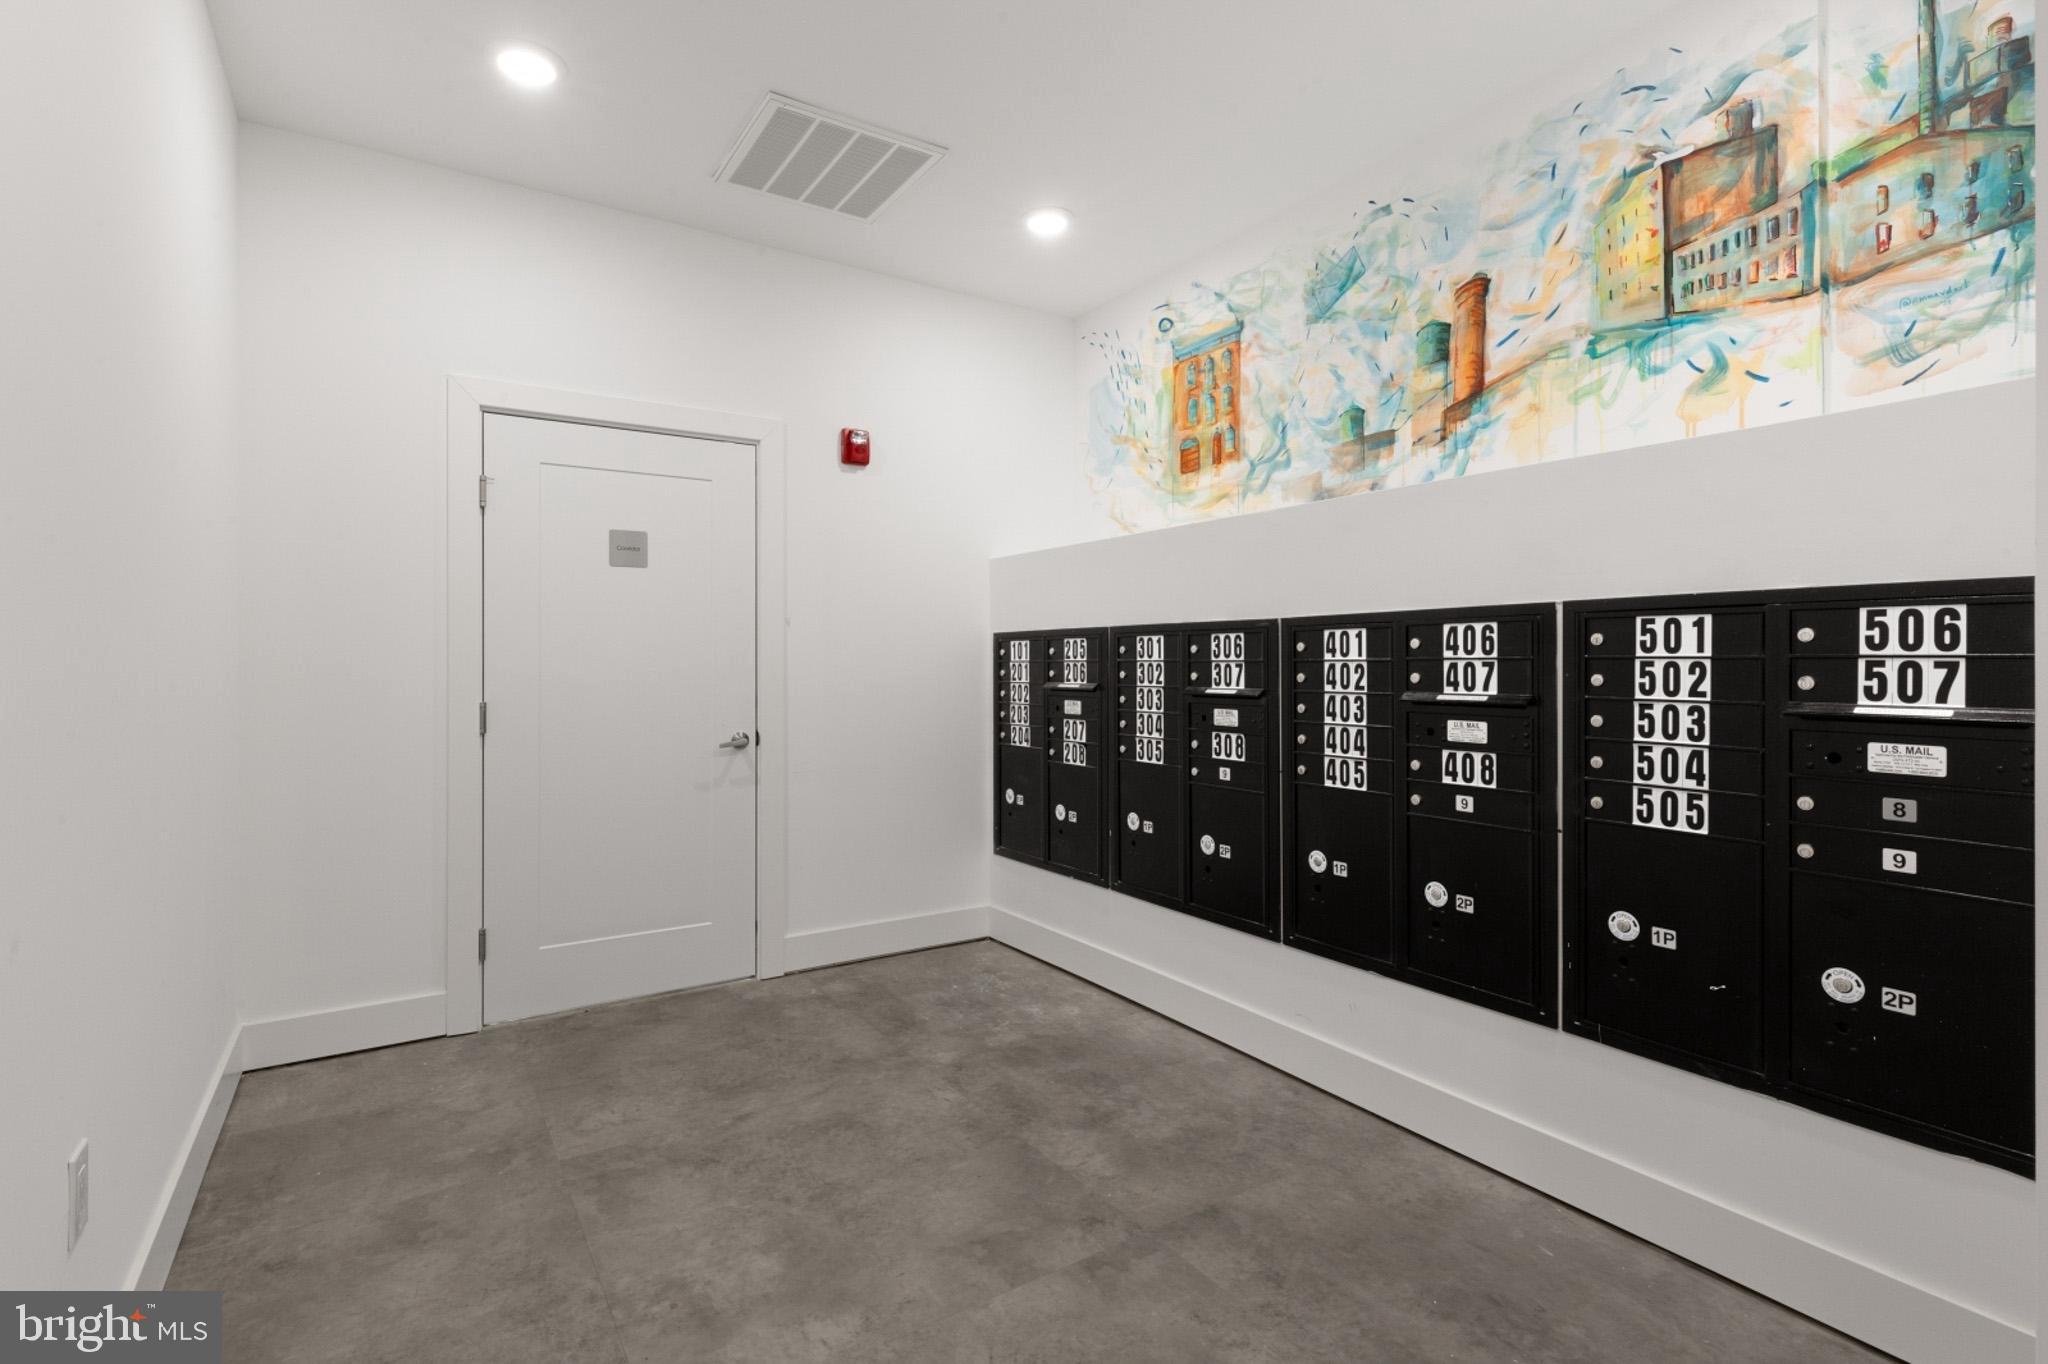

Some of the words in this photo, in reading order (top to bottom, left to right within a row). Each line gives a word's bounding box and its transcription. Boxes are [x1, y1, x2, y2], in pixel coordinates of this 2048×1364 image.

[1446, 625, 1495, 656] 406
[1639, 616, 1706, 654] 501
[1865, 607, 1961, 652] 506
[1011, 642, 1029, 660] 101
[1065, 640, 1086, 660] 205
[1138, 637, 1163, 659] 301
[1212, 634, 1243, 659] 306
[1326, 630, 1364, 658] 401
[1011, 663, 1029, 682] 201
[1065, 662, 1086, 683] 206
[1138, 662, 1163, 685] 302
[1213, 663, 1244, 688] 307
[1326, 662, 1365, 691] 402
[1446, 661, 1496, 692] 407
[1638, 661, 1707, 698] 502
[1863, 660, 1961, 704] 507
[1011, 684, 1029, 704] 202
[1138, 688, 1163, 711] 303
[1011, 705, 1029, 724] 203
[1326, 695, 1365, 723] 403
[1064, 721, 1085, 741] 207
[1138, 714, 1163, 737] 304
[1637, 704, 1706, 742] 503
[1011, 727, 1030, 746] 204
[1213, 733, 1244, 760] 308
[1326, 727, 1365, 756] 404
[1064, 743, 1085, 764] 208
[1137, 740, 1163, 763] 305
[1880, 744, 1901, 754] U.S.
[1905, 746, 1933, 756] MAIL
[1326, 759, 1365, 788] 405
[1444, 751, 1495, 786] 408
[1637, 747, 1706, 787] 504
[1461, 798, 1468, 810] 9
[1637, 789, 1705, 831] 505
[1893, 802, 1906, 818] 8
[1144, 823, 1153, 832] 1P
[1220, 845, 1231, 857] 2P
[1893, 853, 1906, 870] 9
[1334, 863, 1346, 875] 1P
[1457, 897, 1473, 910] 2P
[1653, 930, 1674, 945] 1P
[1884, 991, 1914, 1009] 2P
